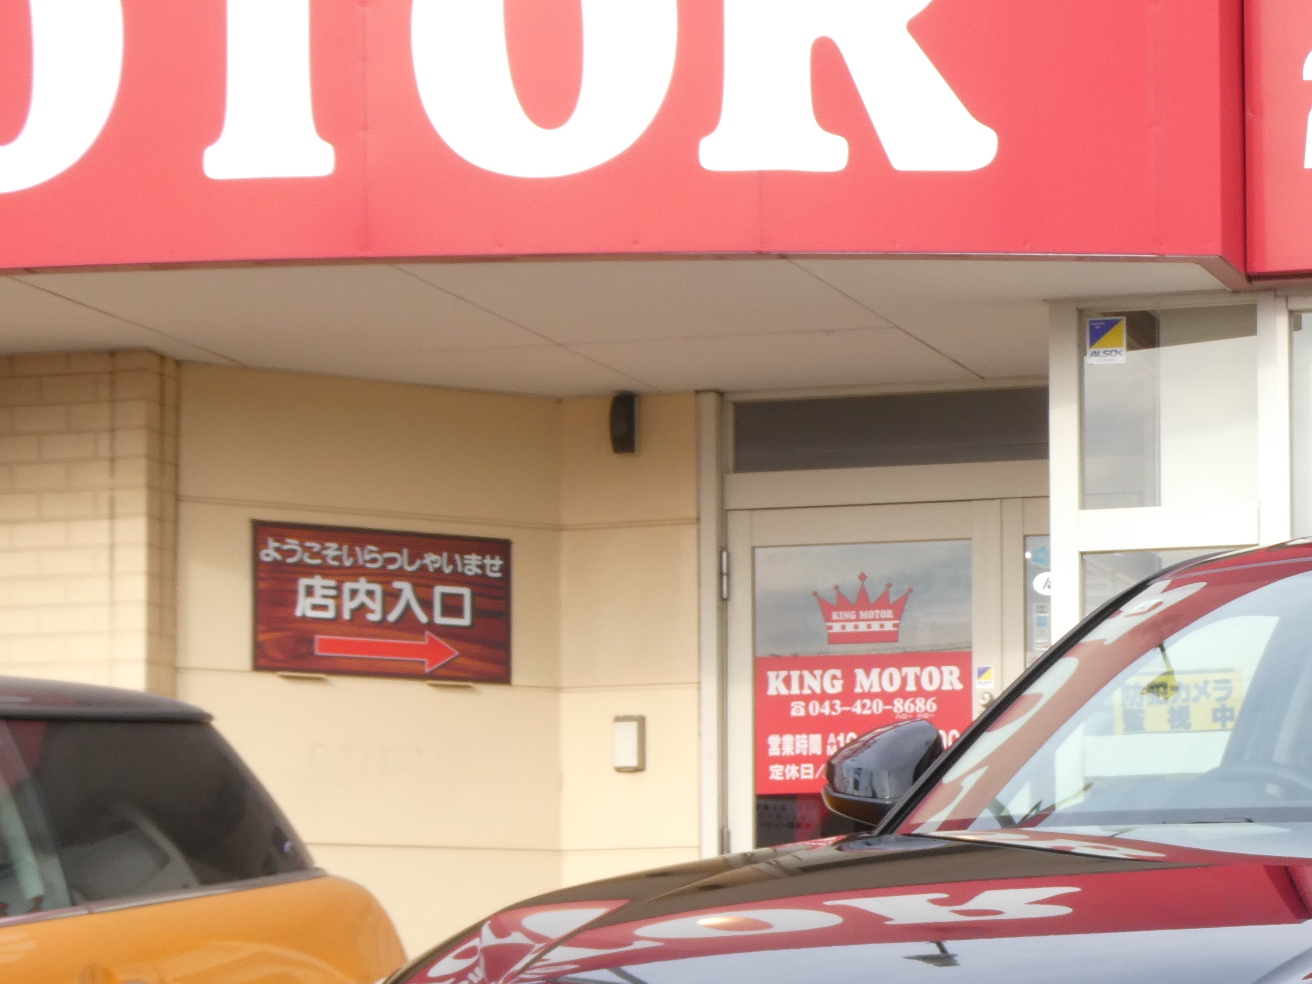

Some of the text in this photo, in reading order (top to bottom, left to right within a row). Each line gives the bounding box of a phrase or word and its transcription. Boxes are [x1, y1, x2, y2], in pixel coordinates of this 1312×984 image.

[294, 575, 473, 628] 店内入口
[831, 609, 894, 621] KING MOTOR
[766, 665, 963, 696] KING MOTOR
[808, 697, 938, 717] 043-420-8686
[768, 733, 822, 757] 営業時間
